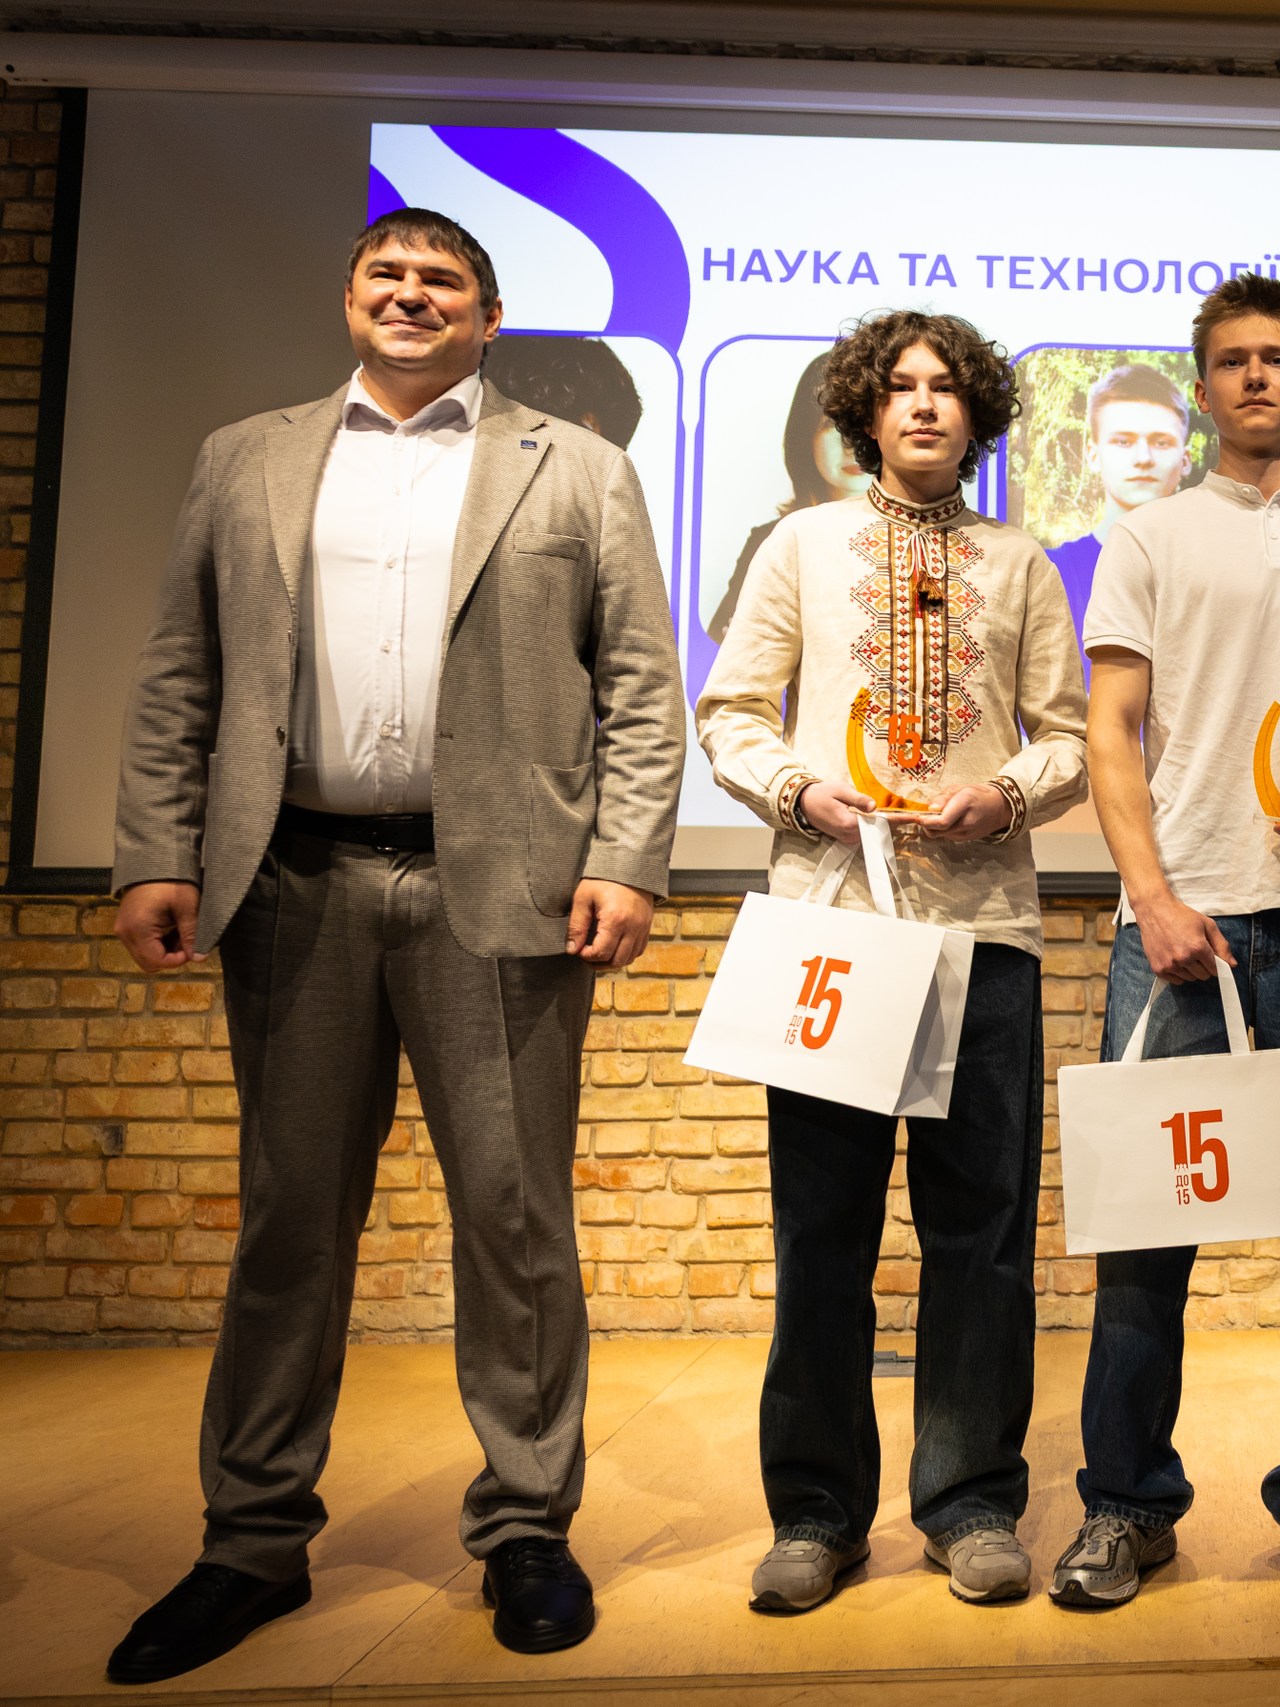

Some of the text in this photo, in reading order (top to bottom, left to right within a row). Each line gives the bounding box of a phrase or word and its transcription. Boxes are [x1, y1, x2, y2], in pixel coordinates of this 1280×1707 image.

[703, 247, 880, 286] НАУКА
[899, 253, 957, 287] ТА
[882, 713, 921, 769] 15
[797, 955, 852, 1050] 15
[784, 1029, 798, 1045] 15
[1160, 1109, 1230, 1203] 15
[1176, 1188, 1191, 1205] 15
